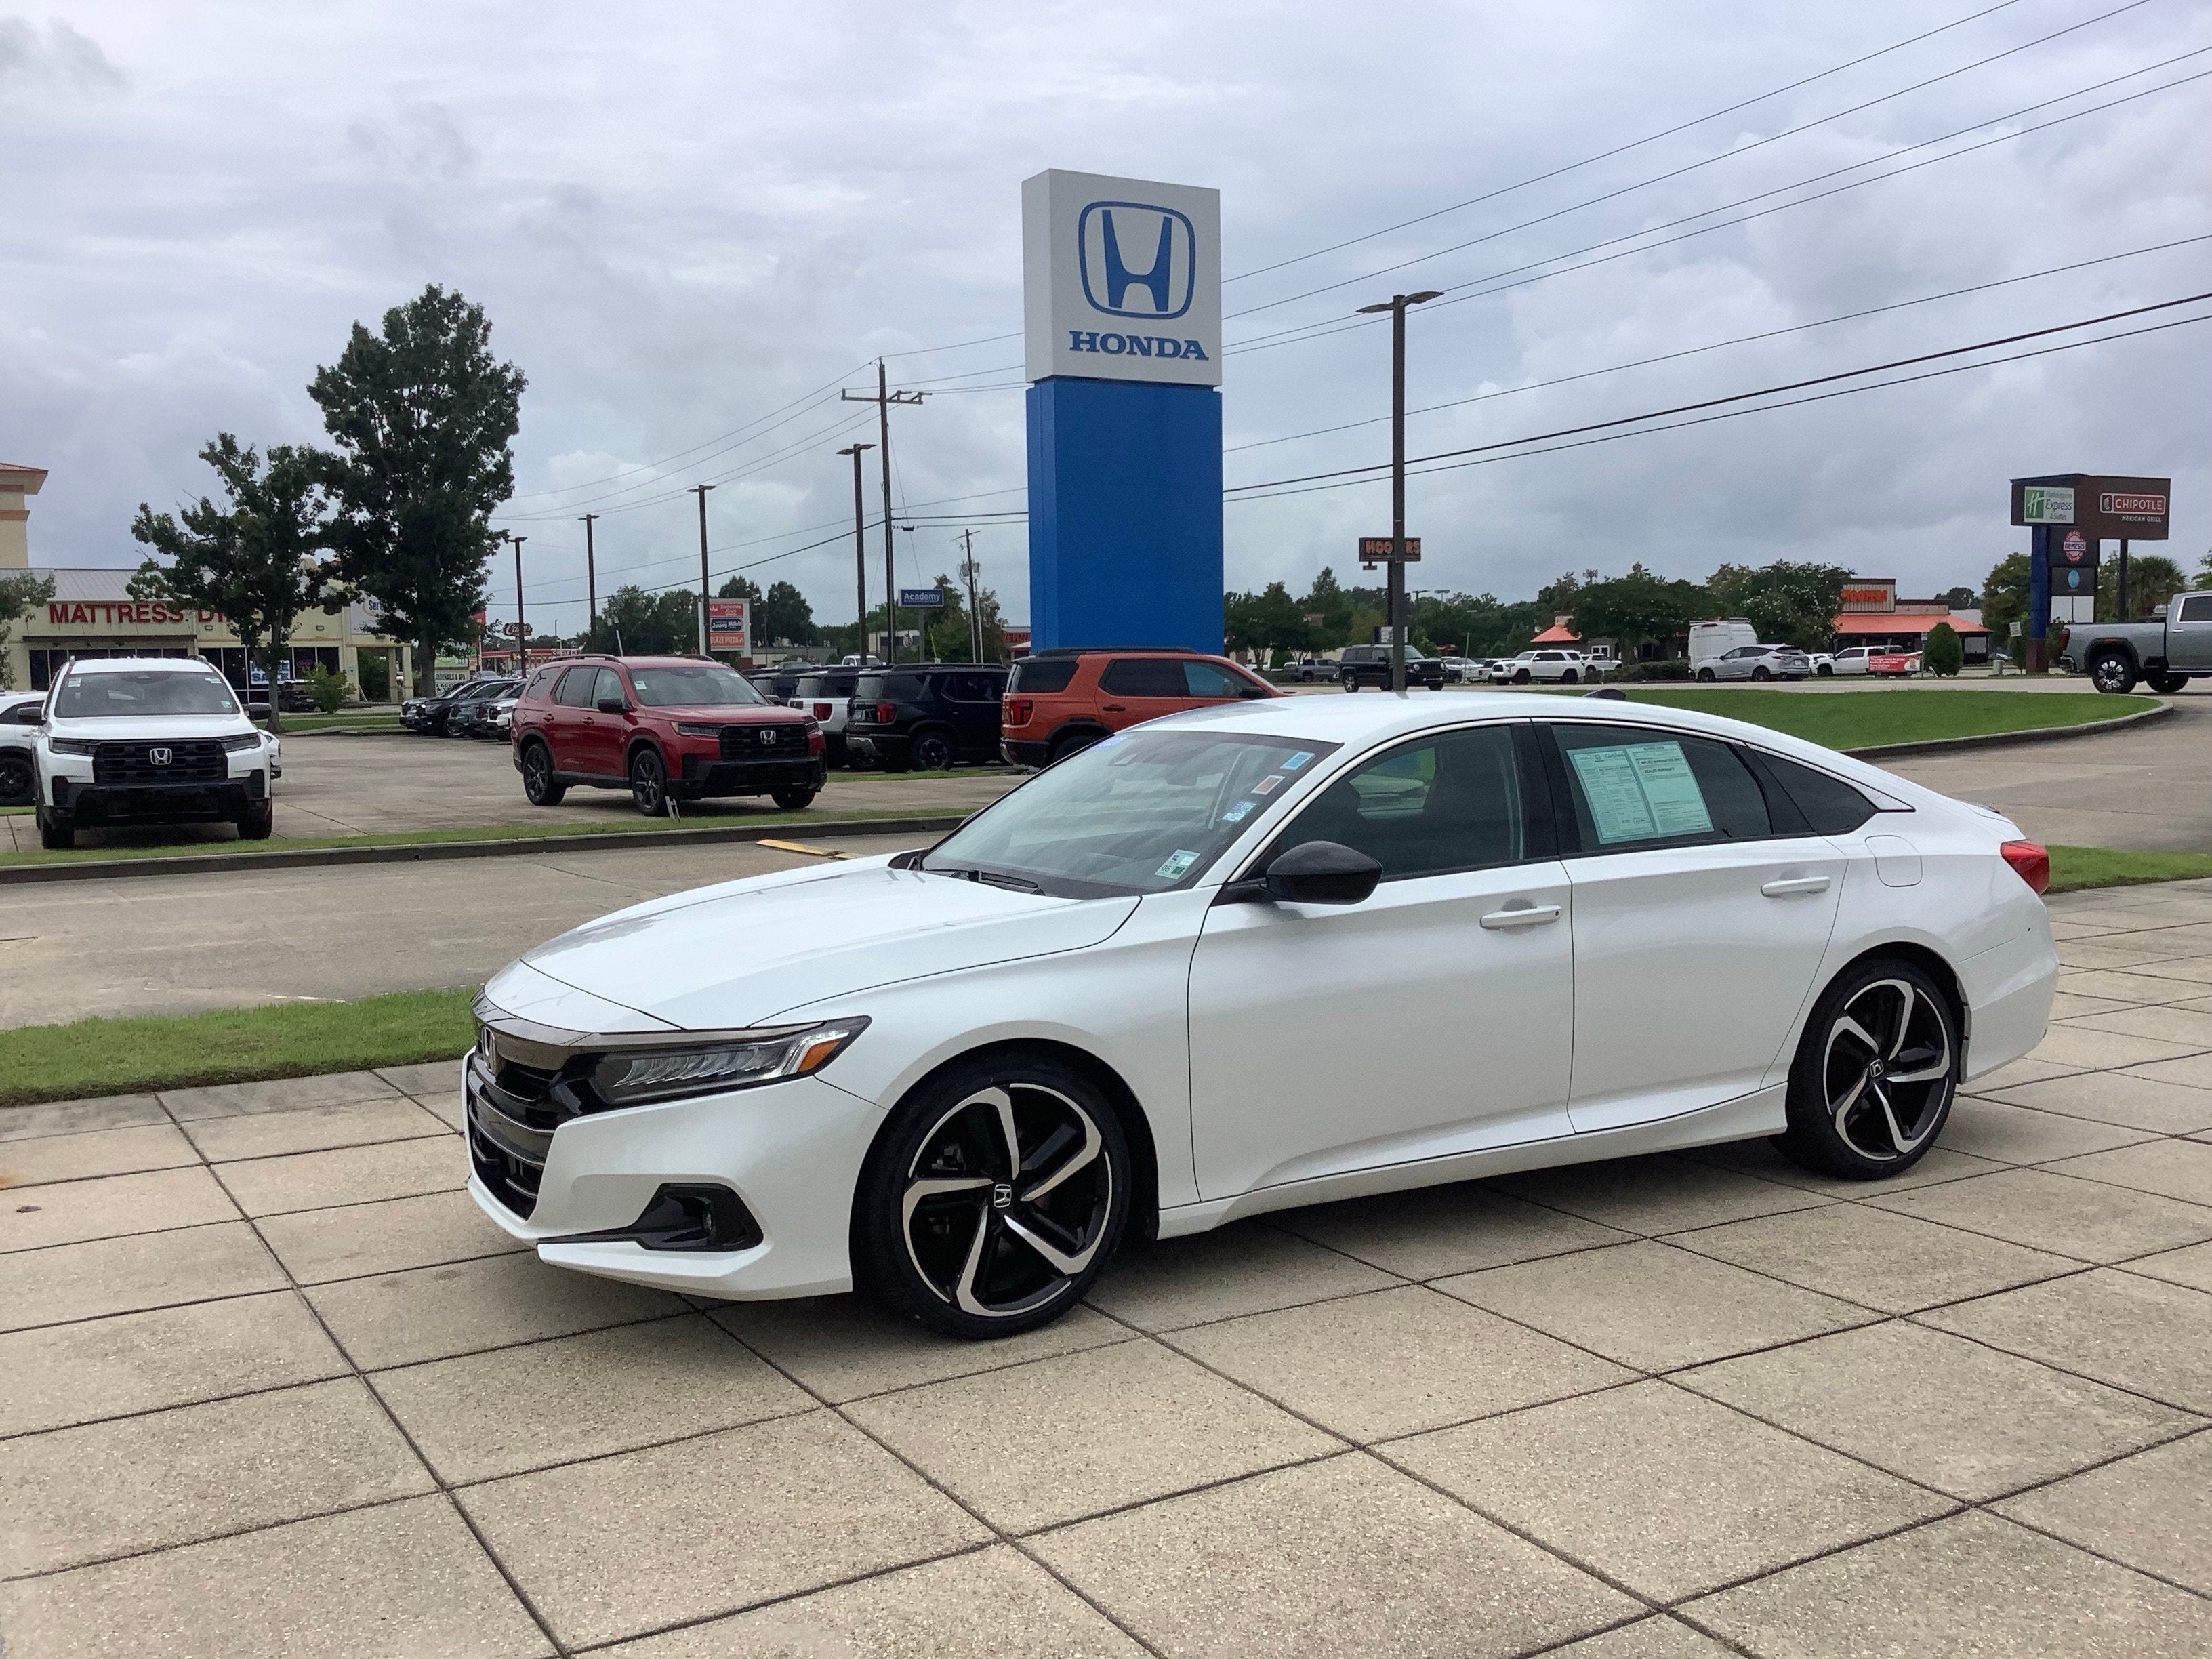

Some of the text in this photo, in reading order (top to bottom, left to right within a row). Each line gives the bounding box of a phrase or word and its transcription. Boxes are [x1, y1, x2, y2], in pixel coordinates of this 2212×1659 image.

[1069, 331, 1209, 361] HONDA
[2045, 499, 2072, 512] Express
[2115, 499, 2163, 510] CHIPOTLE
[1366, 541, 1420, 554] HOORS
[904, 592, 941, 602] Academy
[49, 603, 184, 623] MATTRESS
